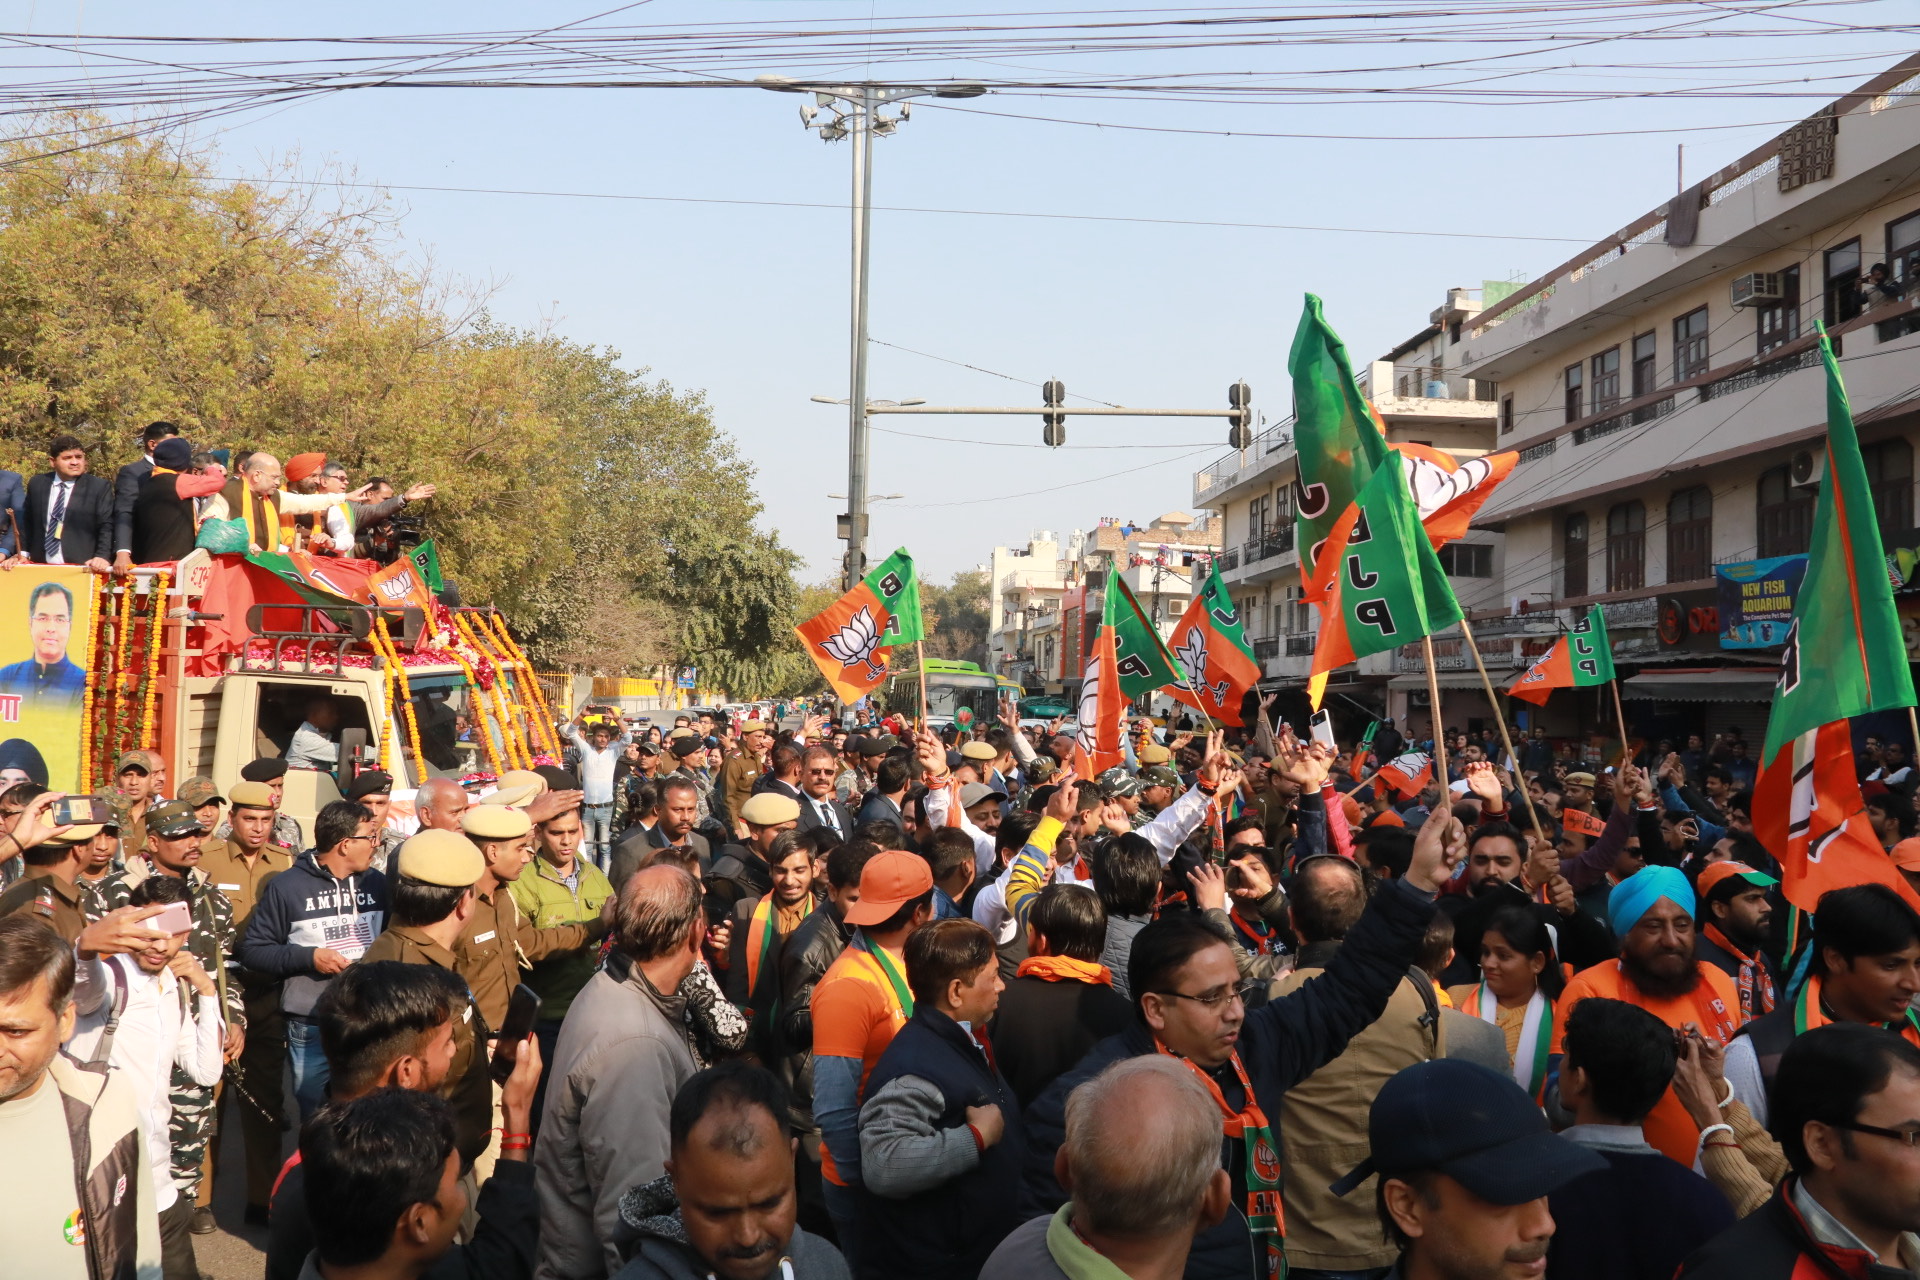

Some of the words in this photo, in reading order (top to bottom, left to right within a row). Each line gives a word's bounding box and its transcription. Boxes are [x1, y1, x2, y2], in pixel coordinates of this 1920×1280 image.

[1742, 582, 1761, 597] NEW
[1763, 579, 1785, 594] FISH
[1742, 596, 1792, 613] AQUARIUM
[1439, 658, 1466, 668] SHAKES
[305, 893, 376, 911] AMRCA
